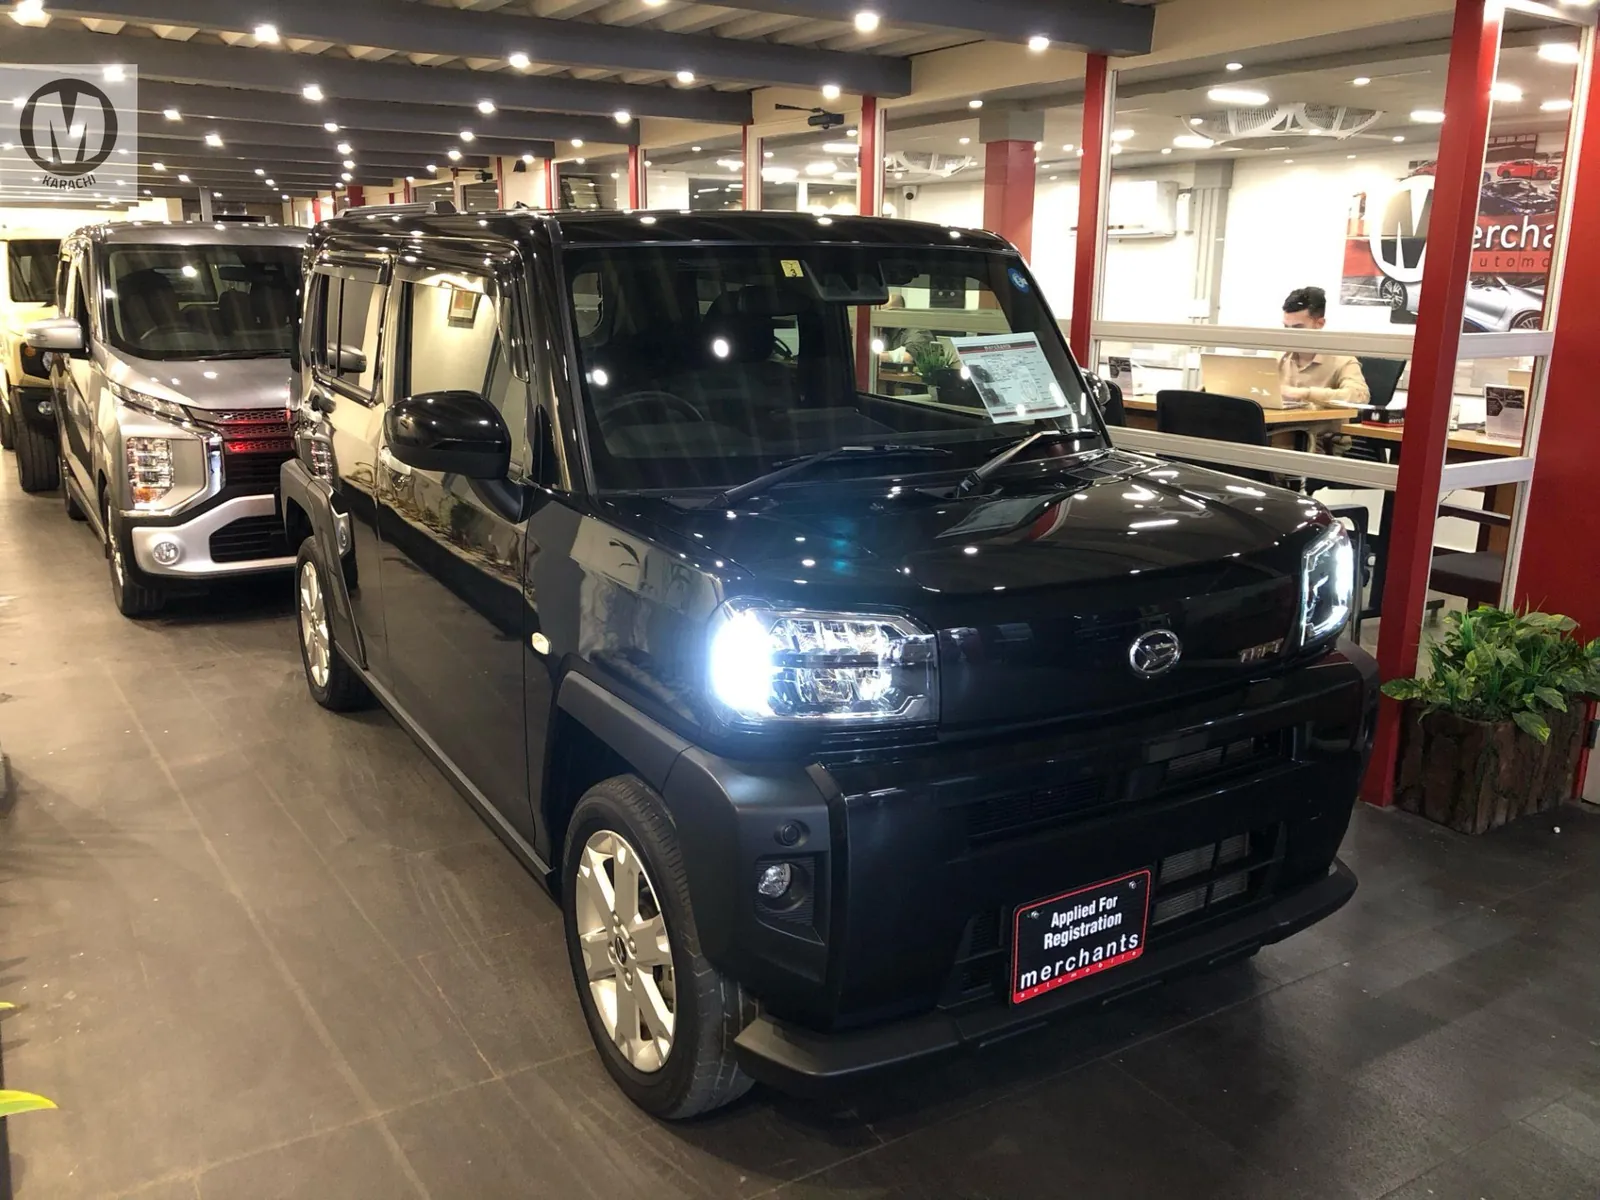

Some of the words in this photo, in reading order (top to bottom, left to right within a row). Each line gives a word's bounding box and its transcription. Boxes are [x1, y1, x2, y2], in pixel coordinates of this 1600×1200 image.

[1479, 257, 1550, 268] utomo
[1050, 900, 1096, 929] Applied
[1098, 895, 1119, 913] For
[1043, 912, 1122, 950] Registration
[1020, 933, 1139, 990] merchants
